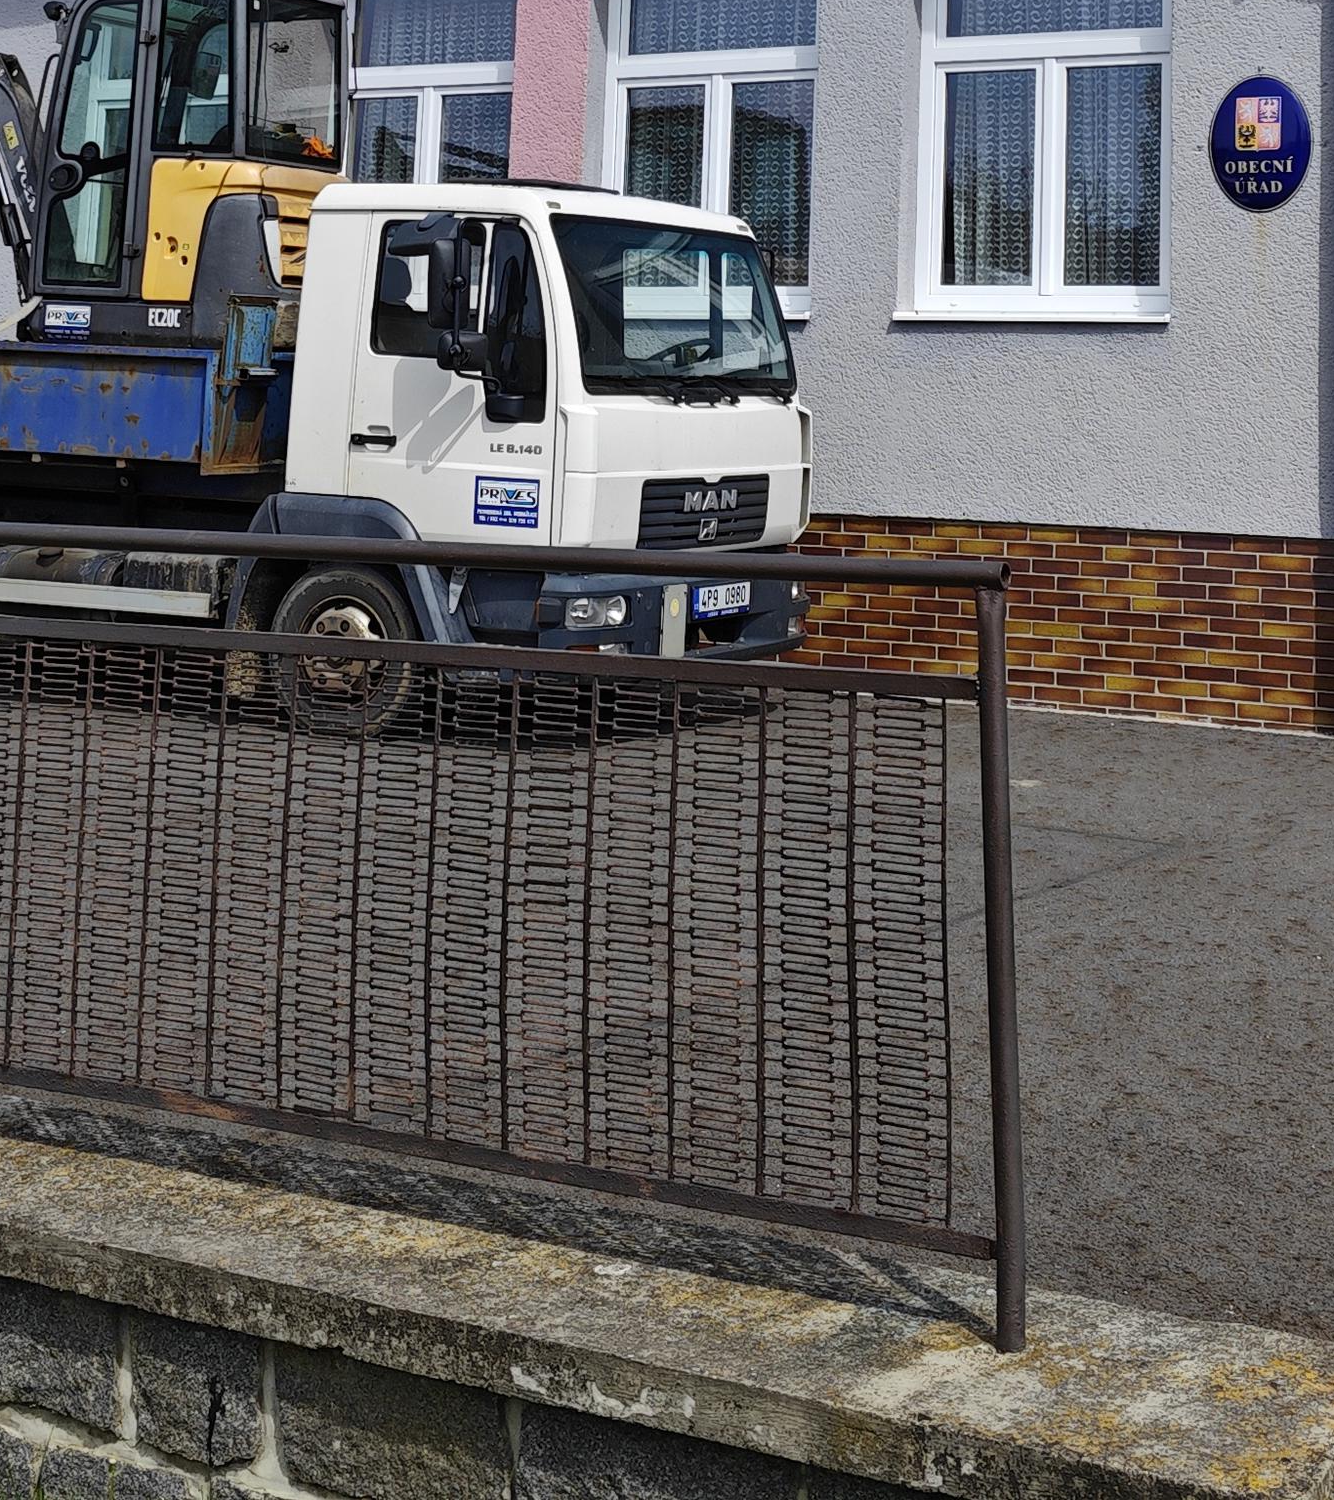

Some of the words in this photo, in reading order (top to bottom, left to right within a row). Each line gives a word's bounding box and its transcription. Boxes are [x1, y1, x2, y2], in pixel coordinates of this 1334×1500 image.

[1224, 155, 1294, 174] OBECNÍ
[1234, 177, 1283, 194] ÚŘAD
[148, 308, 181, 328] EC20C
[489, 443, 504, 453] LE
[506, 444, 543, 455] 8.140
[683, 489, 738, 512] MAN
[701, 589, 719, 609] 4P9
[725, 585, 746, 605] 0980
